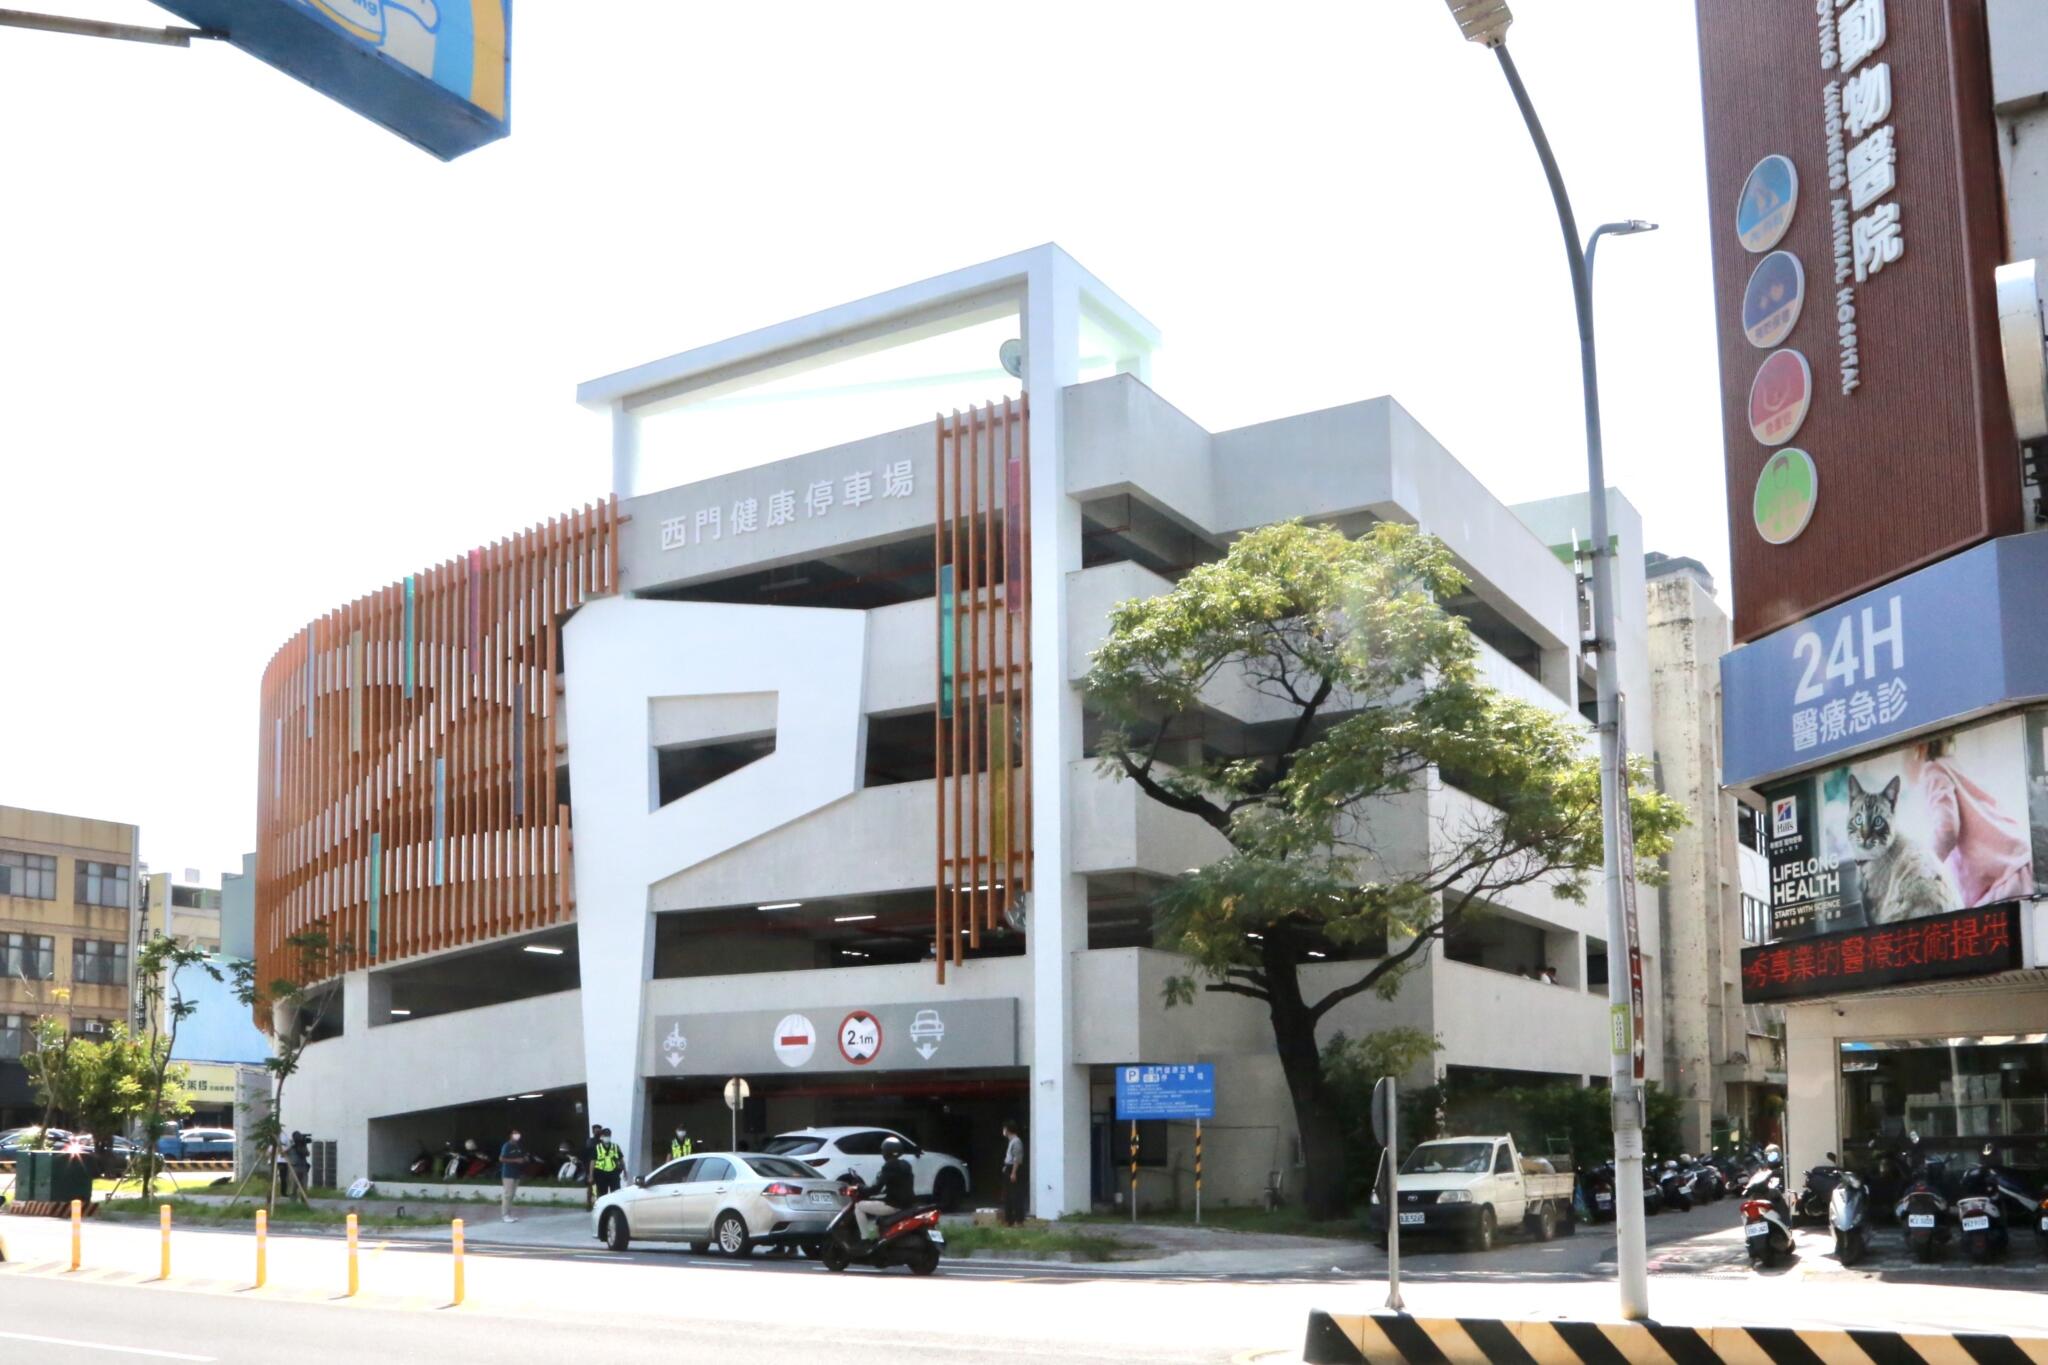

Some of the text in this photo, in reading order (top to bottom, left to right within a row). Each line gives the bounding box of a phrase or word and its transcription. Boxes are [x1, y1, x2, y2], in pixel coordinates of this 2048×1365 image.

[1836, 0, 1904, 283] 動物醫院
[1830, 198, 1854, 285] ANIMAL
[1836, 287, 1861, 396] HOSPITAL
[660, 459, 915, 551] 西門健康停車場
[1792, 595, 1904, 706] 24H
[1792, 676, 1908, 753] 醫療急診
[1773, 852, 1840, 883] LIFELONG
[1773, 871, 1840, 906] HEALTH
[1775, 907, 1796, 920] STARTS
[1797, 904, 1813, 915] WITH
[1814, 899, 1840, 911] SCIENCE
[847, 1029, 874, 1046] 2.1m
[1128, 1070, 1137, 1081] P
